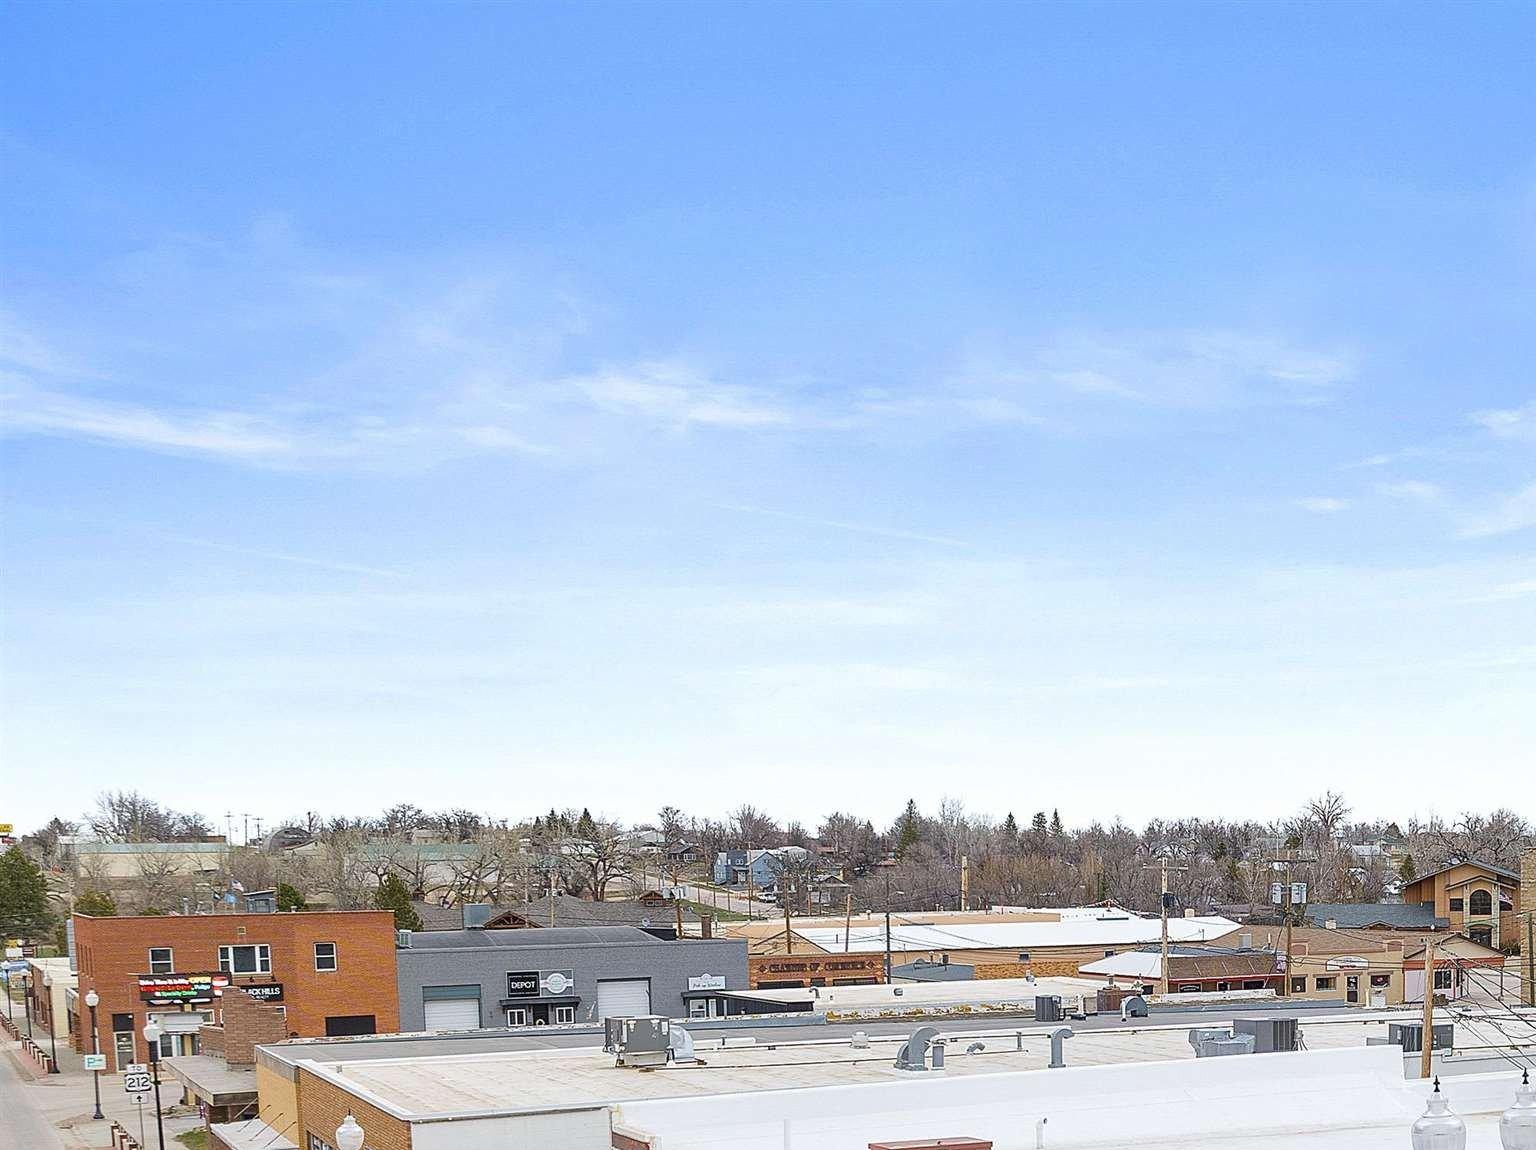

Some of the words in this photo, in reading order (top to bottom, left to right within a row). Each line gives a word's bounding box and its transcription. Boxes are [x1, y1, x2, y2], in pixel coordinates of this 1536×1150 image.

[511, 981, 535, 990] DEPOT
[261, 987, 281, 996] HILLS
[127, 1076, 149, 1088] 212
